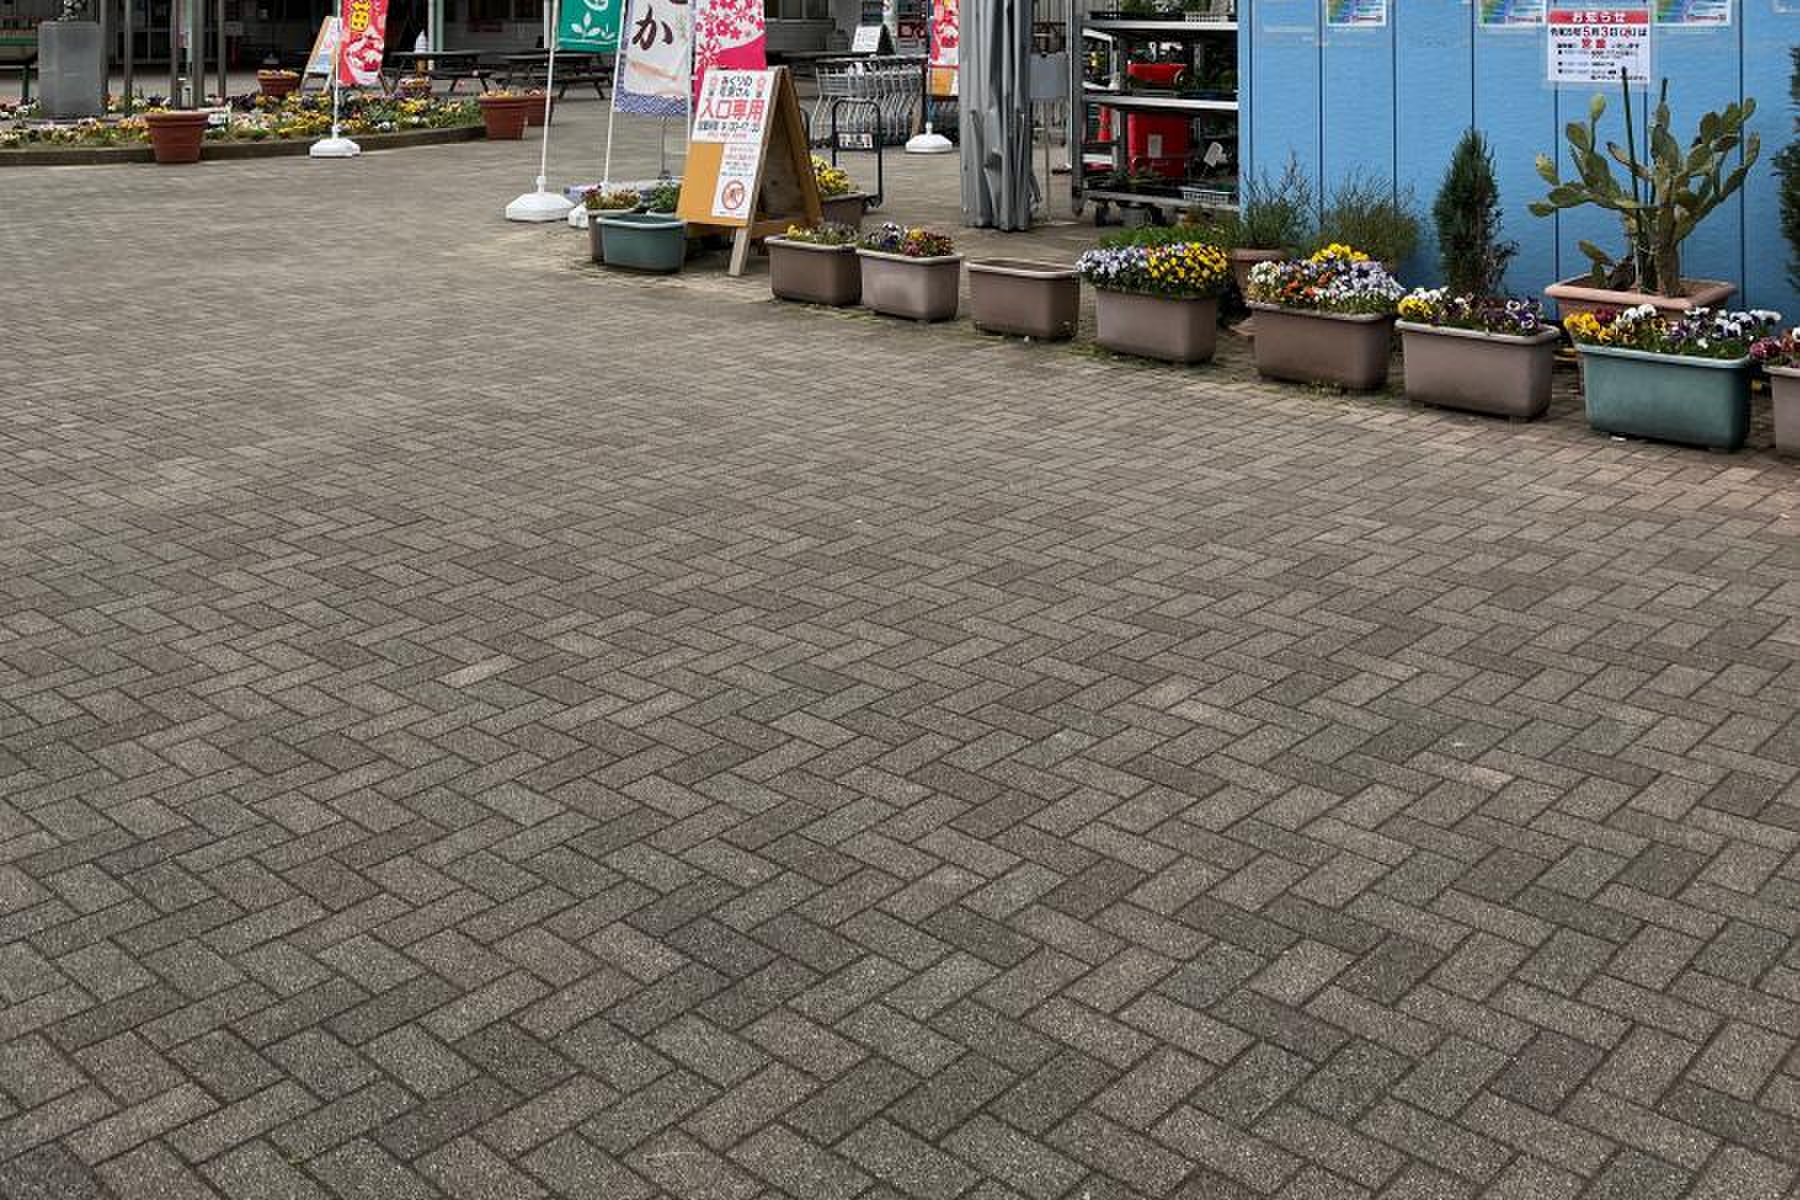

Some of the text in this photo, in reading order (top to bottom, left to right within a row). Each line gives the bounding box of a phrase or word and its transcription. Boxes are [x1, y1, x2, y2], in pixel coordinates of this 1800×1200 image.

[1572, 11, 1627, 23] お知らせ
[699, 98, 765, 121] 入口専用
